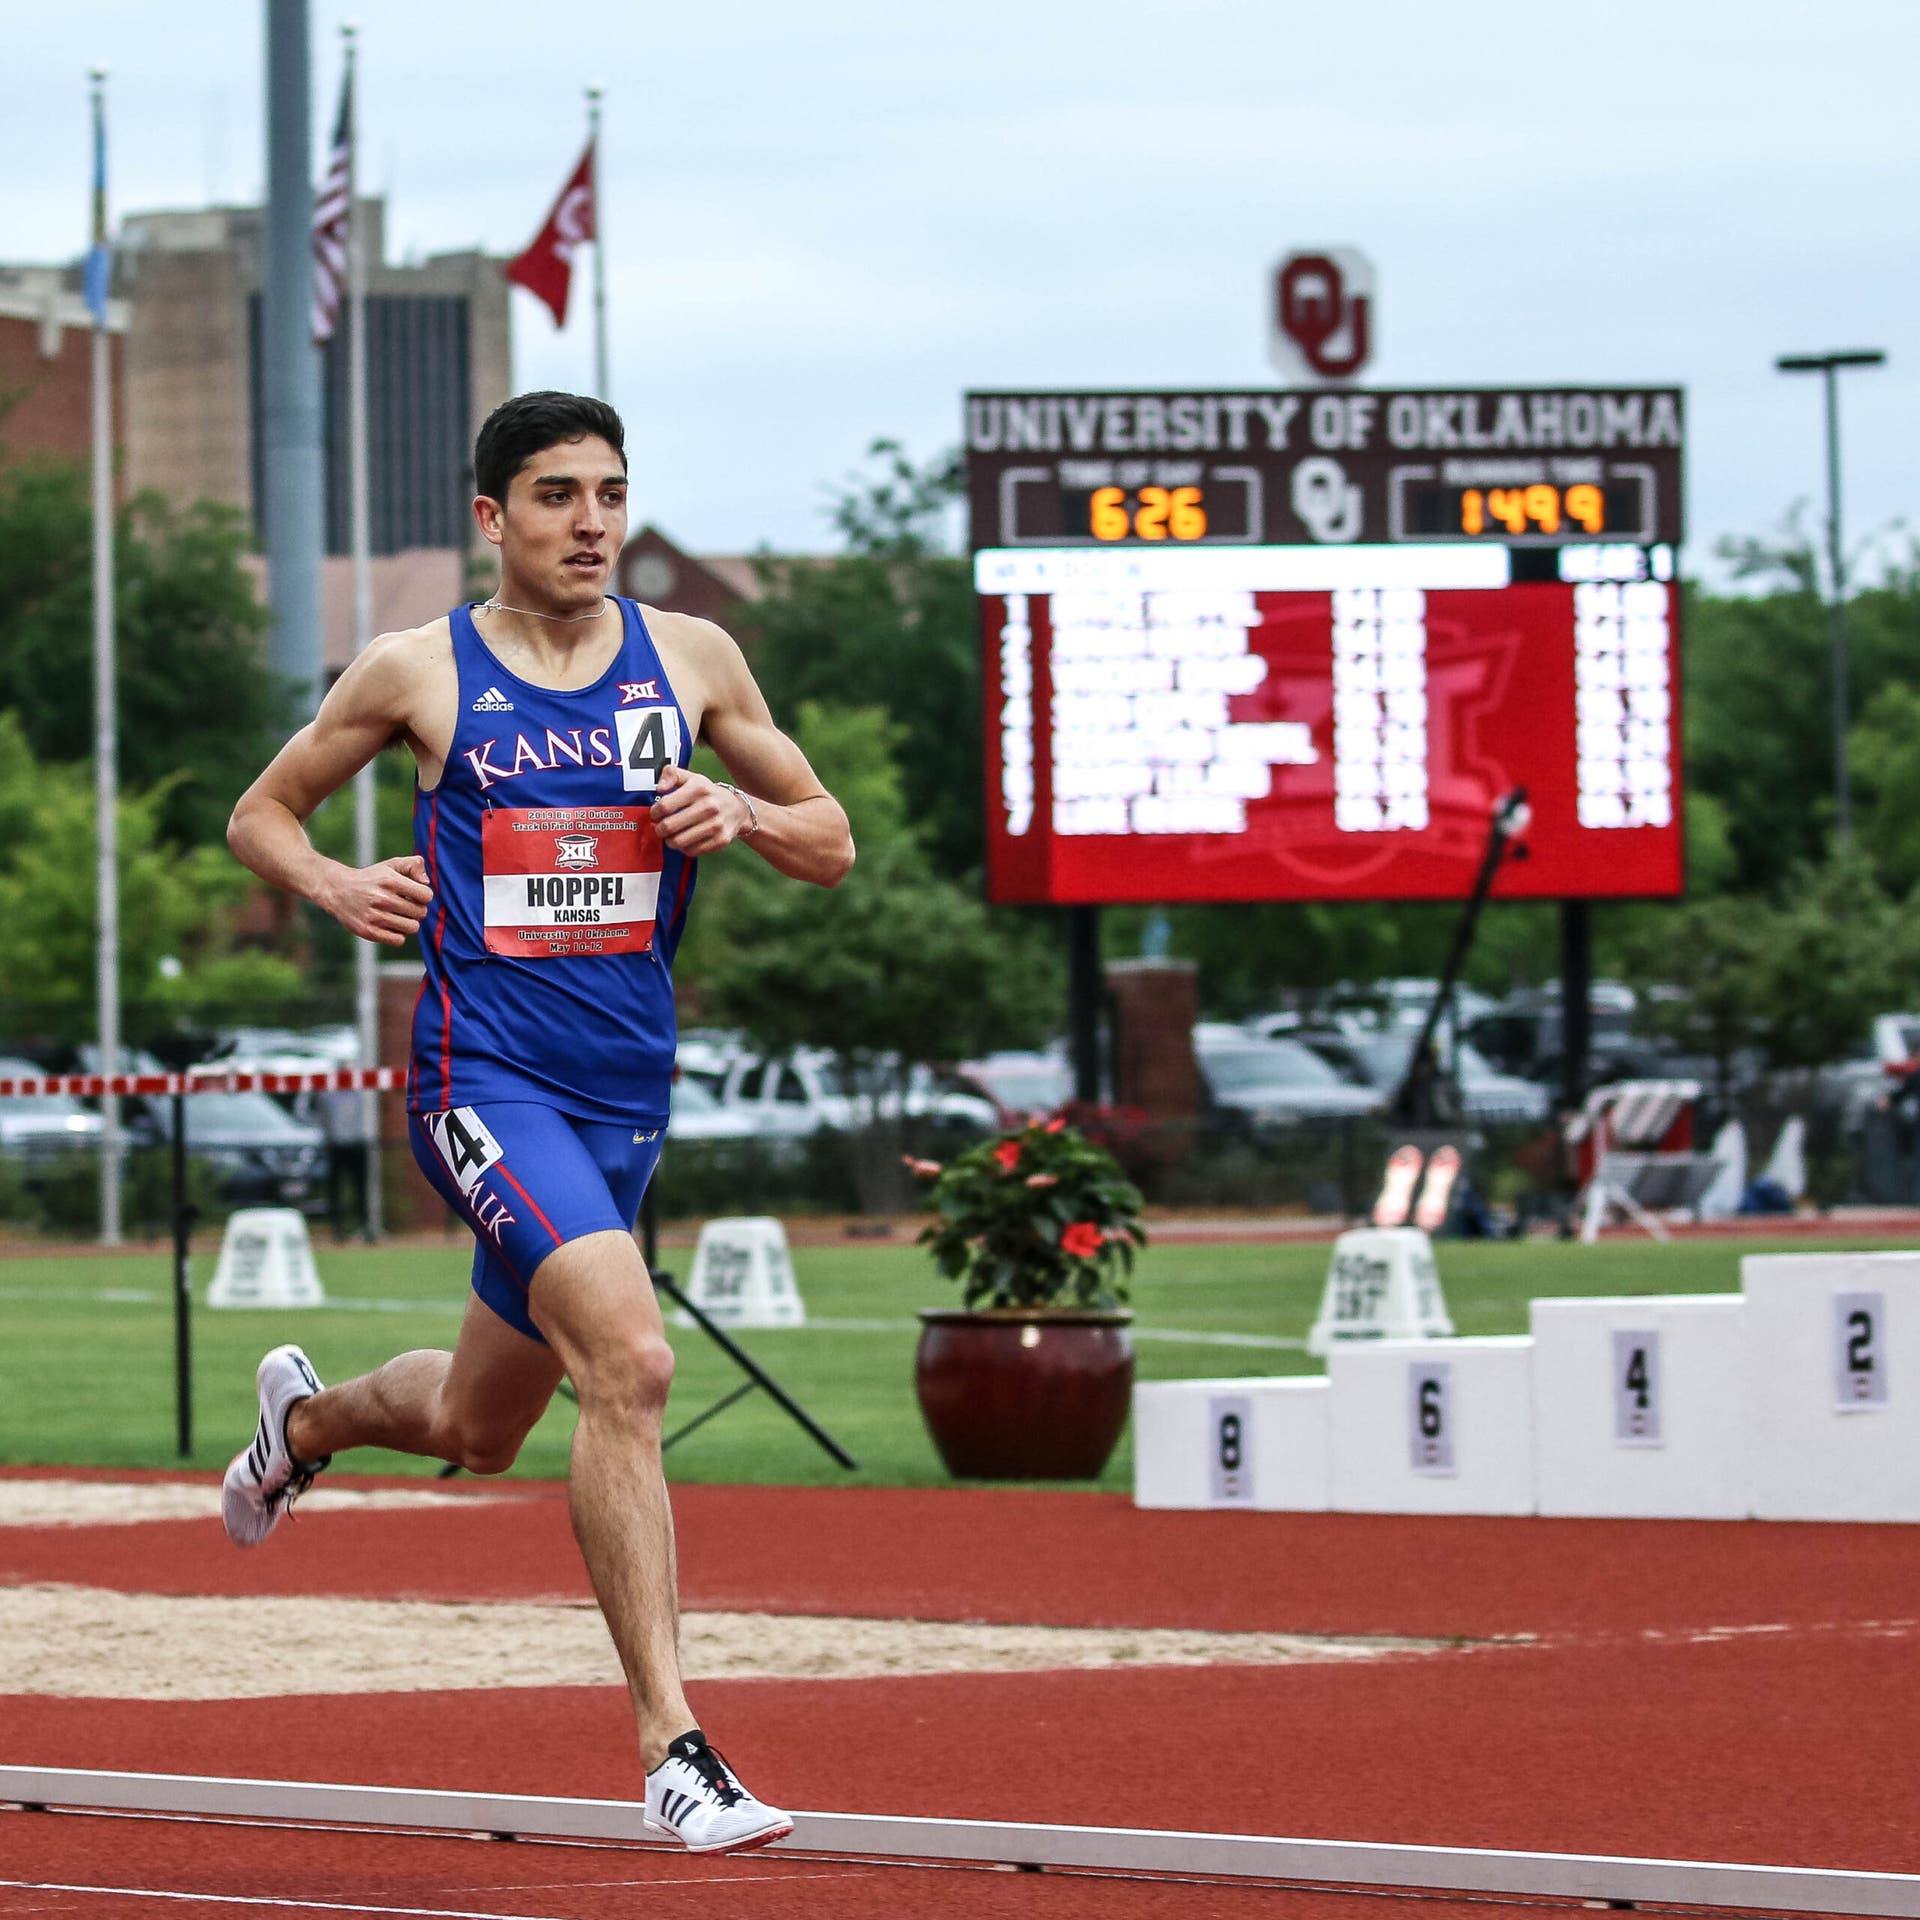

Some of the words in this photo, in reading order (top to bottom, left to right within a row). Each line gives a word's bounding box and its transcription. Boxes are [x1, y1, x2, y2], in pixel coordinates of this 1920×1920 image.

[1278, 256, 1369, 377] OU
[970, 396, 1299, 451] UNIVERSITY
[1310, 395, 1376, 450] OF
[1387, 393, 1681, 448] OKLAHOMA
[1291, 456, 1363, 544] OU
[472, 701, 515, 712] adidas
[617, 680, 661, 705] XII
[463, 728, 623, 791] KANS
[628, 712, 671, 786] 4
[512, 822, 541, 831] Track
[551, 822, 573, 830] Field
[576, 822, 638, 831] Championship
[528, 811, 553, 820] 2019
[556, 811, 571, 821] Big
[574, 811, 586, 819] 12
[589, 810, 624, 819] Outdoor
[558, 841, 595, 863] XII
[527, 877, 625, 907] HOPPEL
[554, 909, 600, 922] KANSAS
[518, 930, 570, 940] University
[573, 930, 583, 939] of
[585, 928, 630, 938] Oklahoma
[549, 943, 570, 952] May
[573, 942, 602, 951] 10-12
[443, 1109, 488, 1180] 4
[469, 1180, 517, 1247] ALK
[1847, 1310, 1874, 1373] 2
[1624, 1348, 1650, 1409] 4
[1418, 1378, 1442, 1439] 6
[1219, 1413, 1241, 1472] 8
